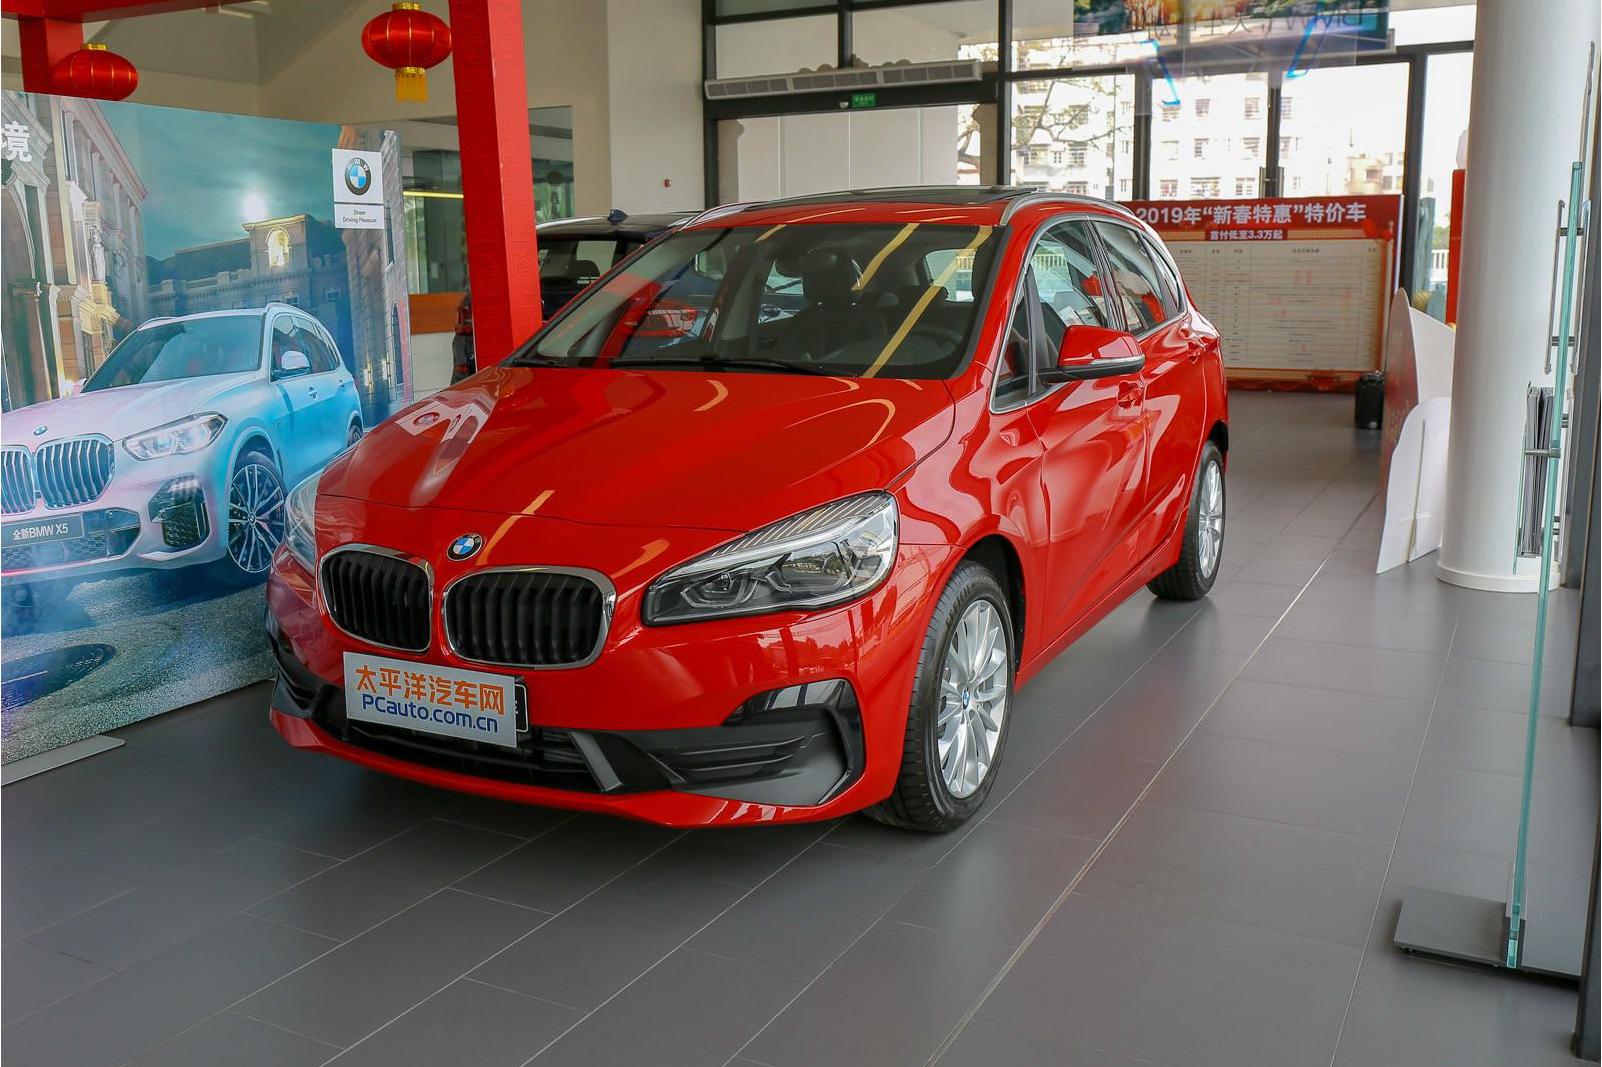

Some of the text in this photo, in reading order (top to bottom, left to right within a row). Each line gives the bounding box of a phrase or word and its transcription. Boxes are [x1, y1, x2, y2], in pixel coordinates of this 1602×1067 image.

[12, 523, 69, 541] 全新BMW X5
[355, 665, 505, 716] 太平洋汽车网
[362, 693, 499, 733] PCauto.com.cn
